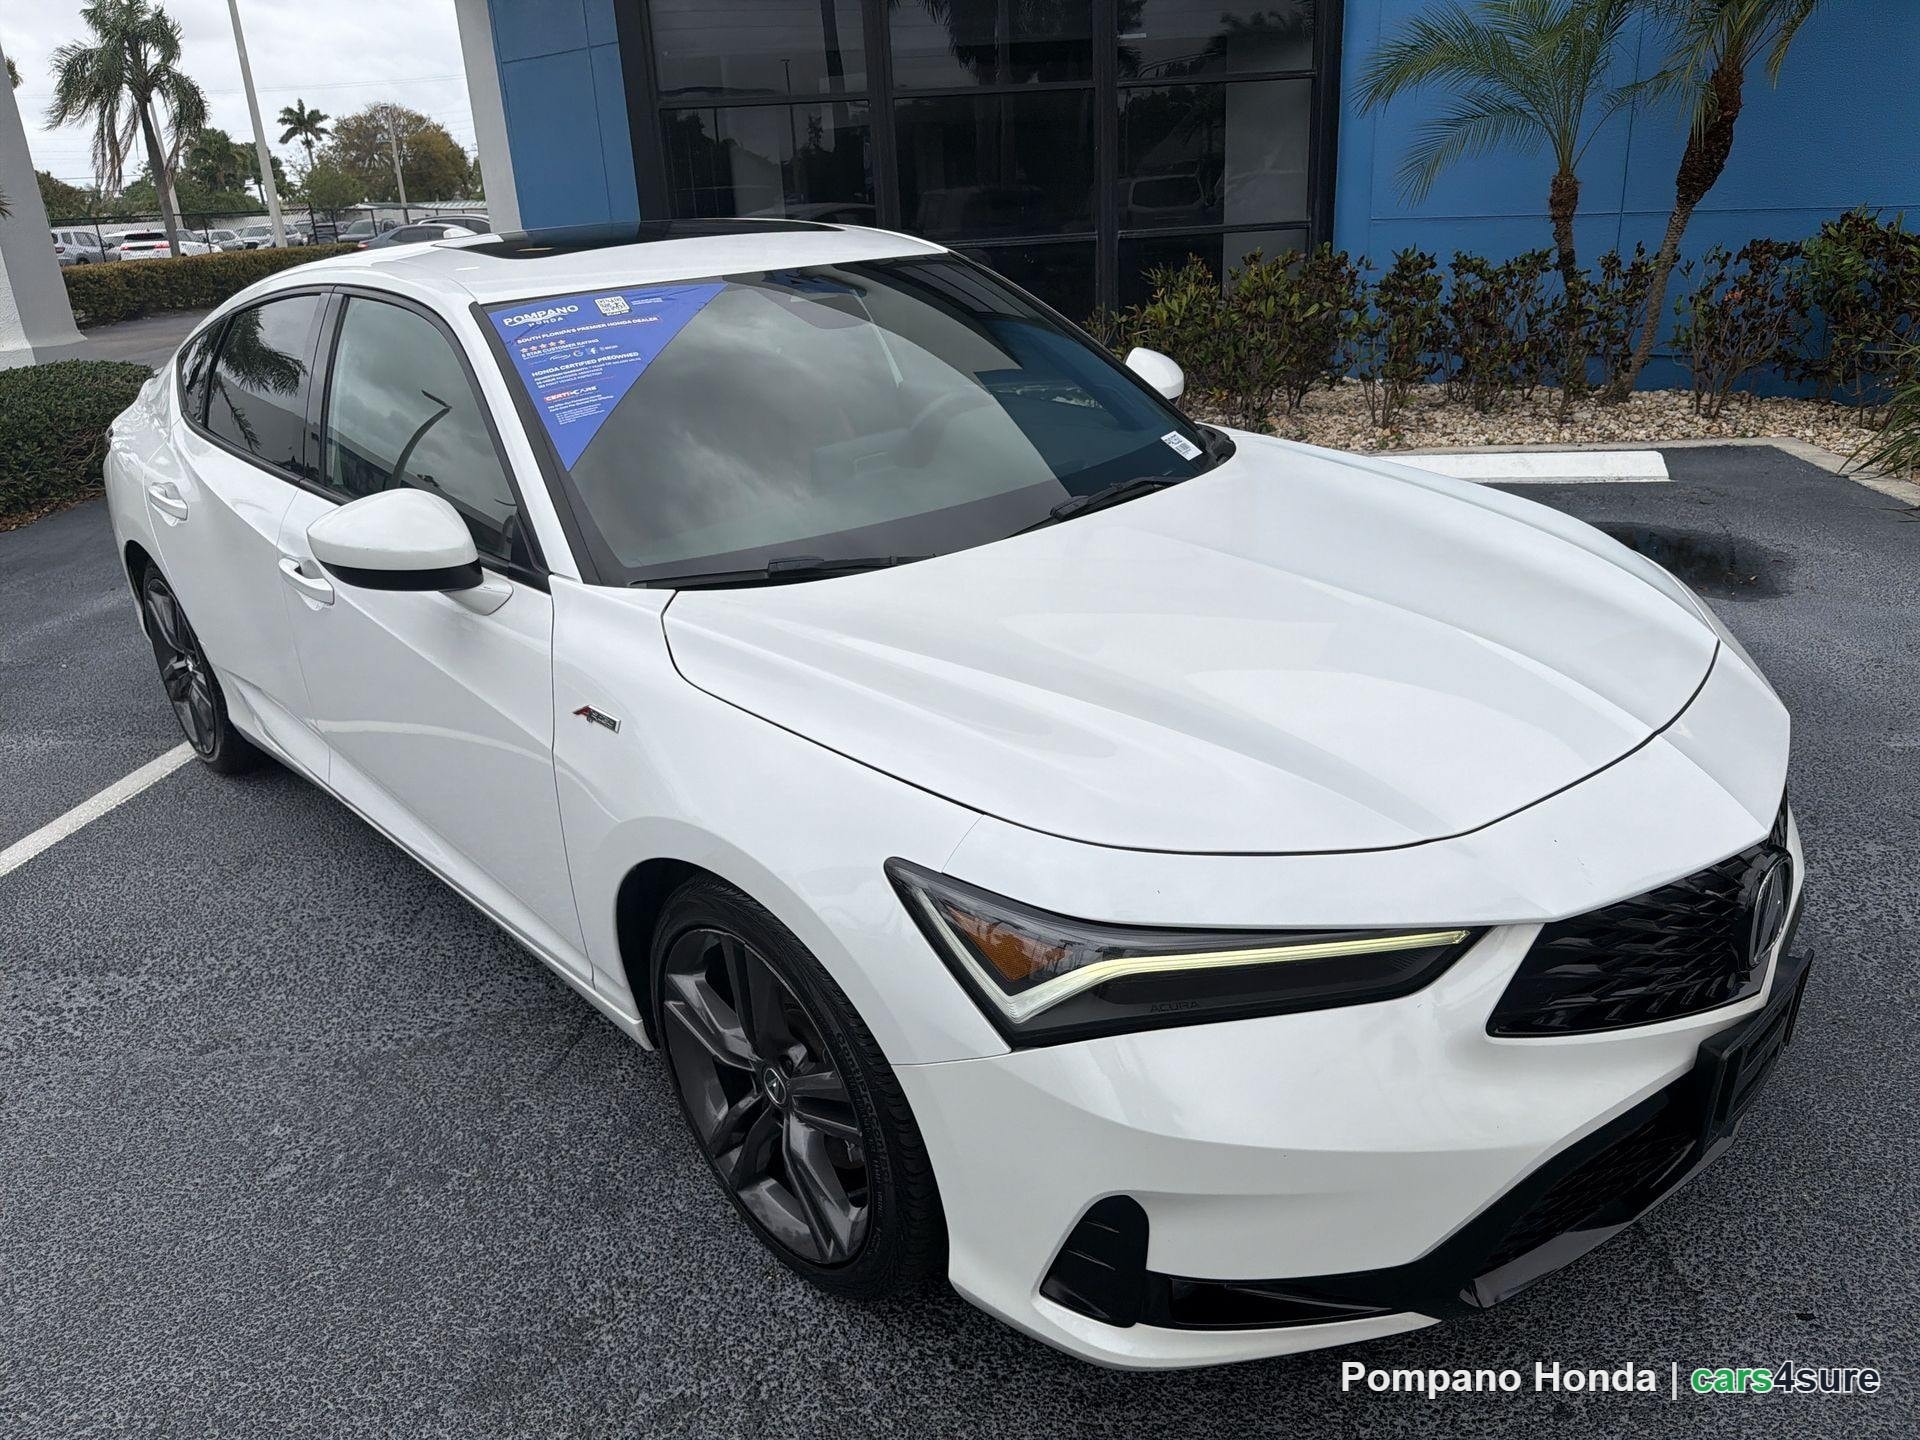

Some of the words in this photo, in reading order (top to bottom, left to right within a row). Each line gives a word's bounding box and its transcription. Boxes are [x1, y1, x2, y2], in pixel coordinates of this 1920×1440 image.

[503, 305, 579, 327] POMPANO
[528, 317, 564, 328] HONDA
[517, 335, 542, 344] SOUTH
[542, 328, 577, 339] FLORIDA'S
[577, 323, 607, 332] PREMIER
[542, 342, 577, 353] CUSTOMER
[577, 338, 600, 346] RATING
[531, 367, 560, 377] HONDA
[560, 359, 597, 371] CERTIFIED
[598, 352, 639, 363] PREOWNED
[1150, 1000, 1201, 1012] ACURA
